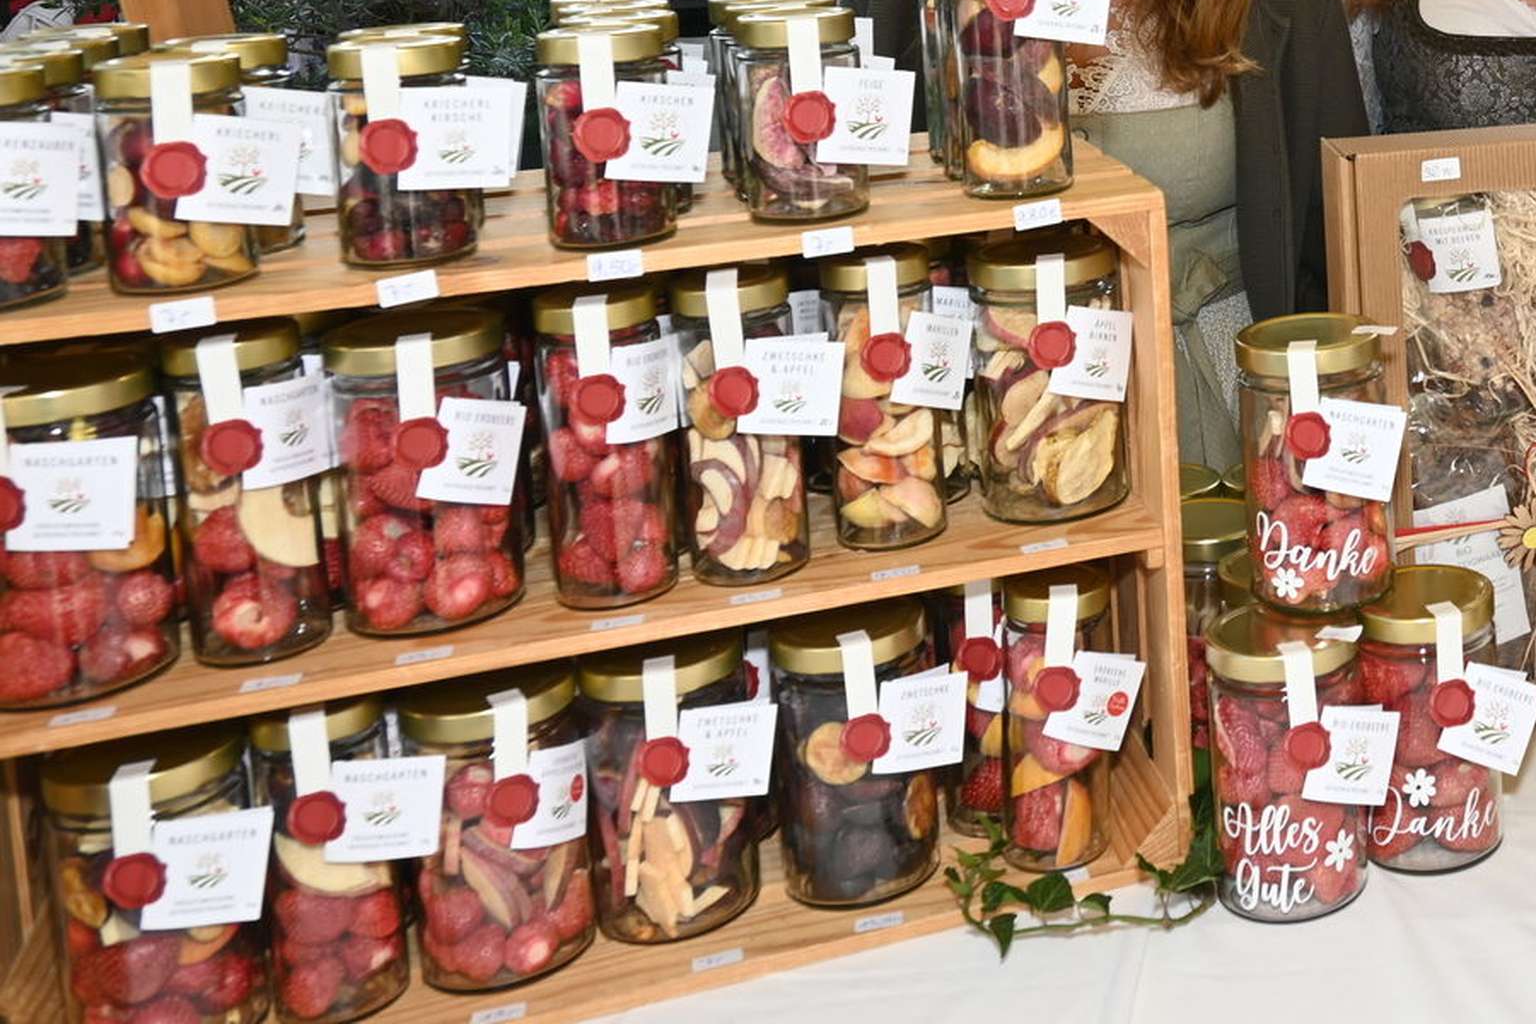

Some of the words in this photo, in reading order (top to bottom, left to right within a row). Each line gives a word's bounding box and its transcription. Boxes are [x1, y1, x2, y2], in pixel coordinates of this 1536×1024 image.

[640, 94, 695, 107] KIRSCHEN
[23, 455, 119, 469] NASCHGARTEN
[1256, 511, 1378, 582] Danke
[1223, 802, 1323, 857] Alles
[1236, 856, 1317, 915] Gute
